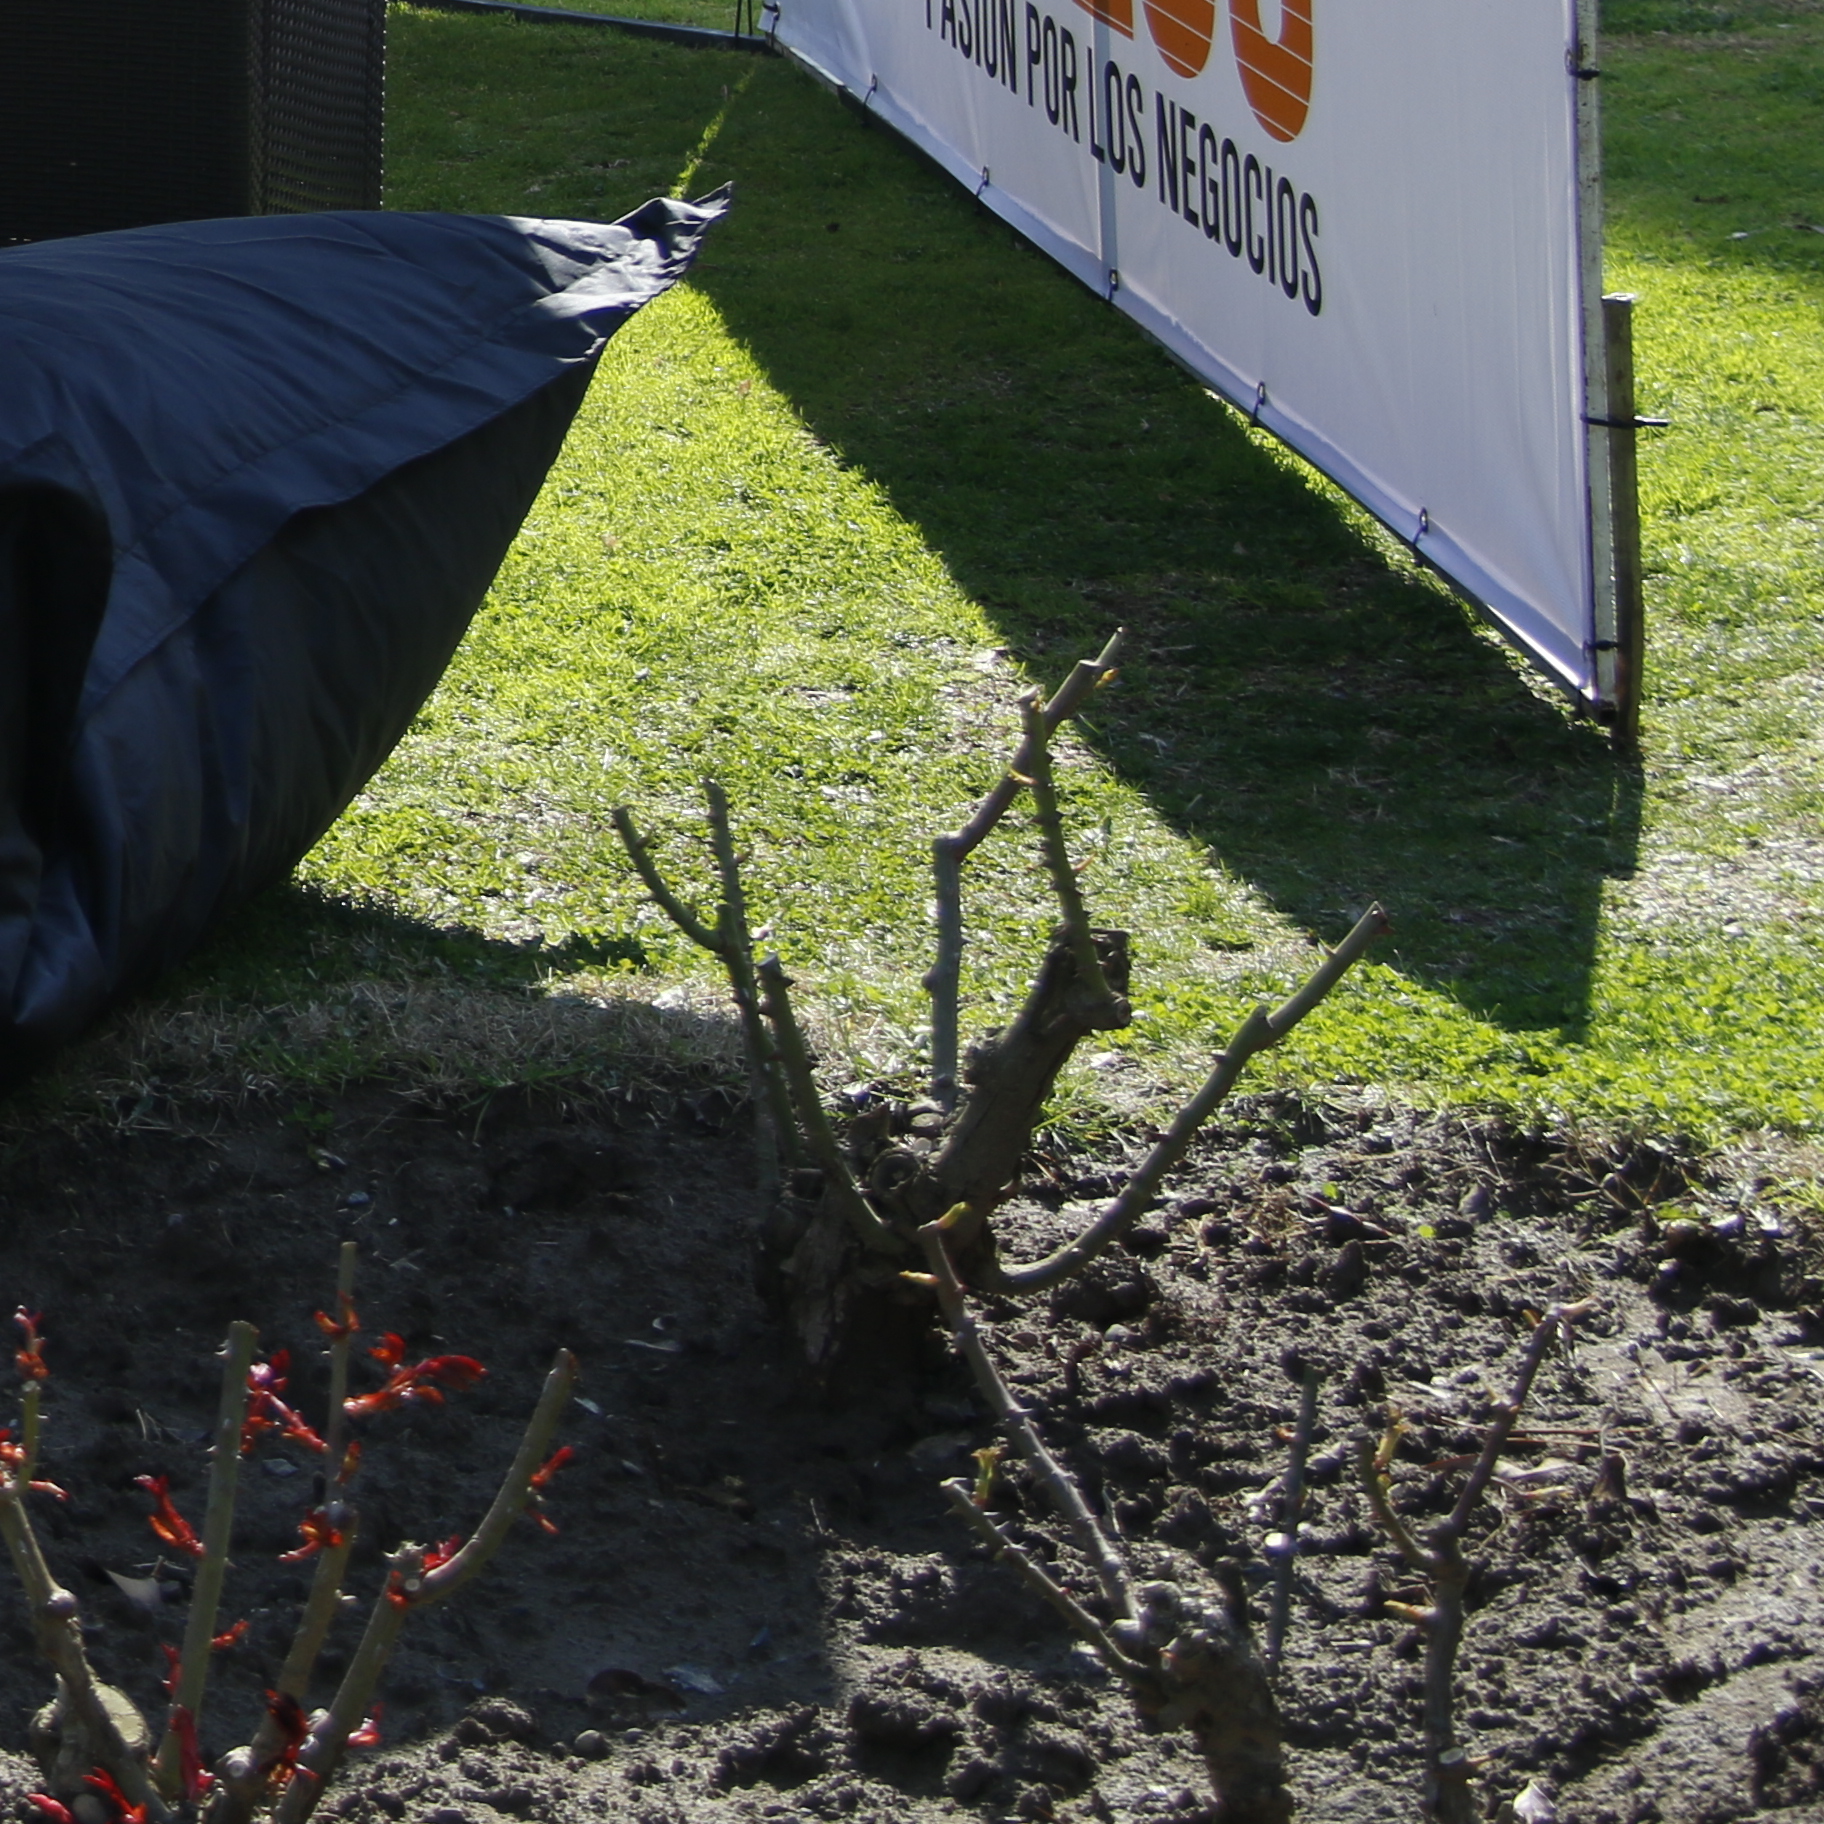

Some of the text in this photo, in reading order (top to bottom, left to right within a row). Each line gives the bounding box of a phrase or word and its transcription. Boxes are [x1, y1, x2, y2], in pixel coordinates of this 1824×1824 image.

[1025, 0, 1080, 144] POR
[1086, 45, 1146, 189] LOS
[1155, 90, 1322, 317] NEGOCIOS
